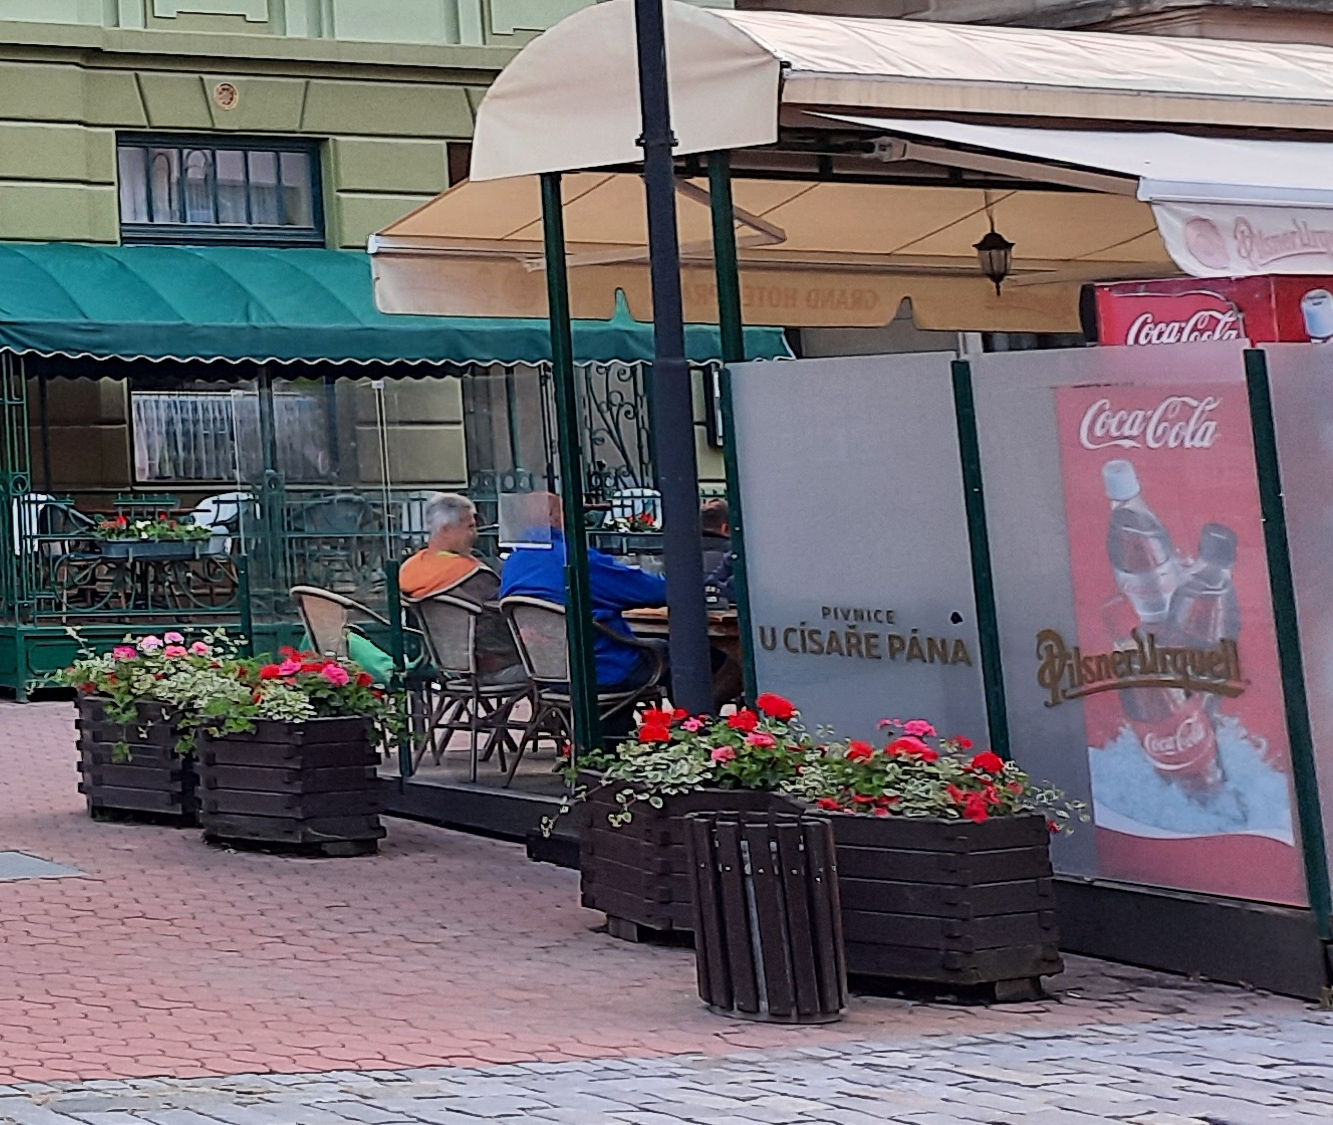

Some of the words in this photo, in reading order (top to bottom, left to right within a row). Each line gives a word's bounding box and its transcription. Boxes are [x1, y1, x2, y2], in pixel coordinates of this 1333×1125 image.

[1080, 395, 1222, 449] Coca-Cola
[821, 605, 896, 625] PIVNICE
[759, 626, 778, 651] U
[782, 620, 881, 659] CÍSAŘE
[887, 628, 973, 667] PÁNA
[1035, 627, 1138, 708] Pilsner
[1131, 627, 1243, 698] Urquell
